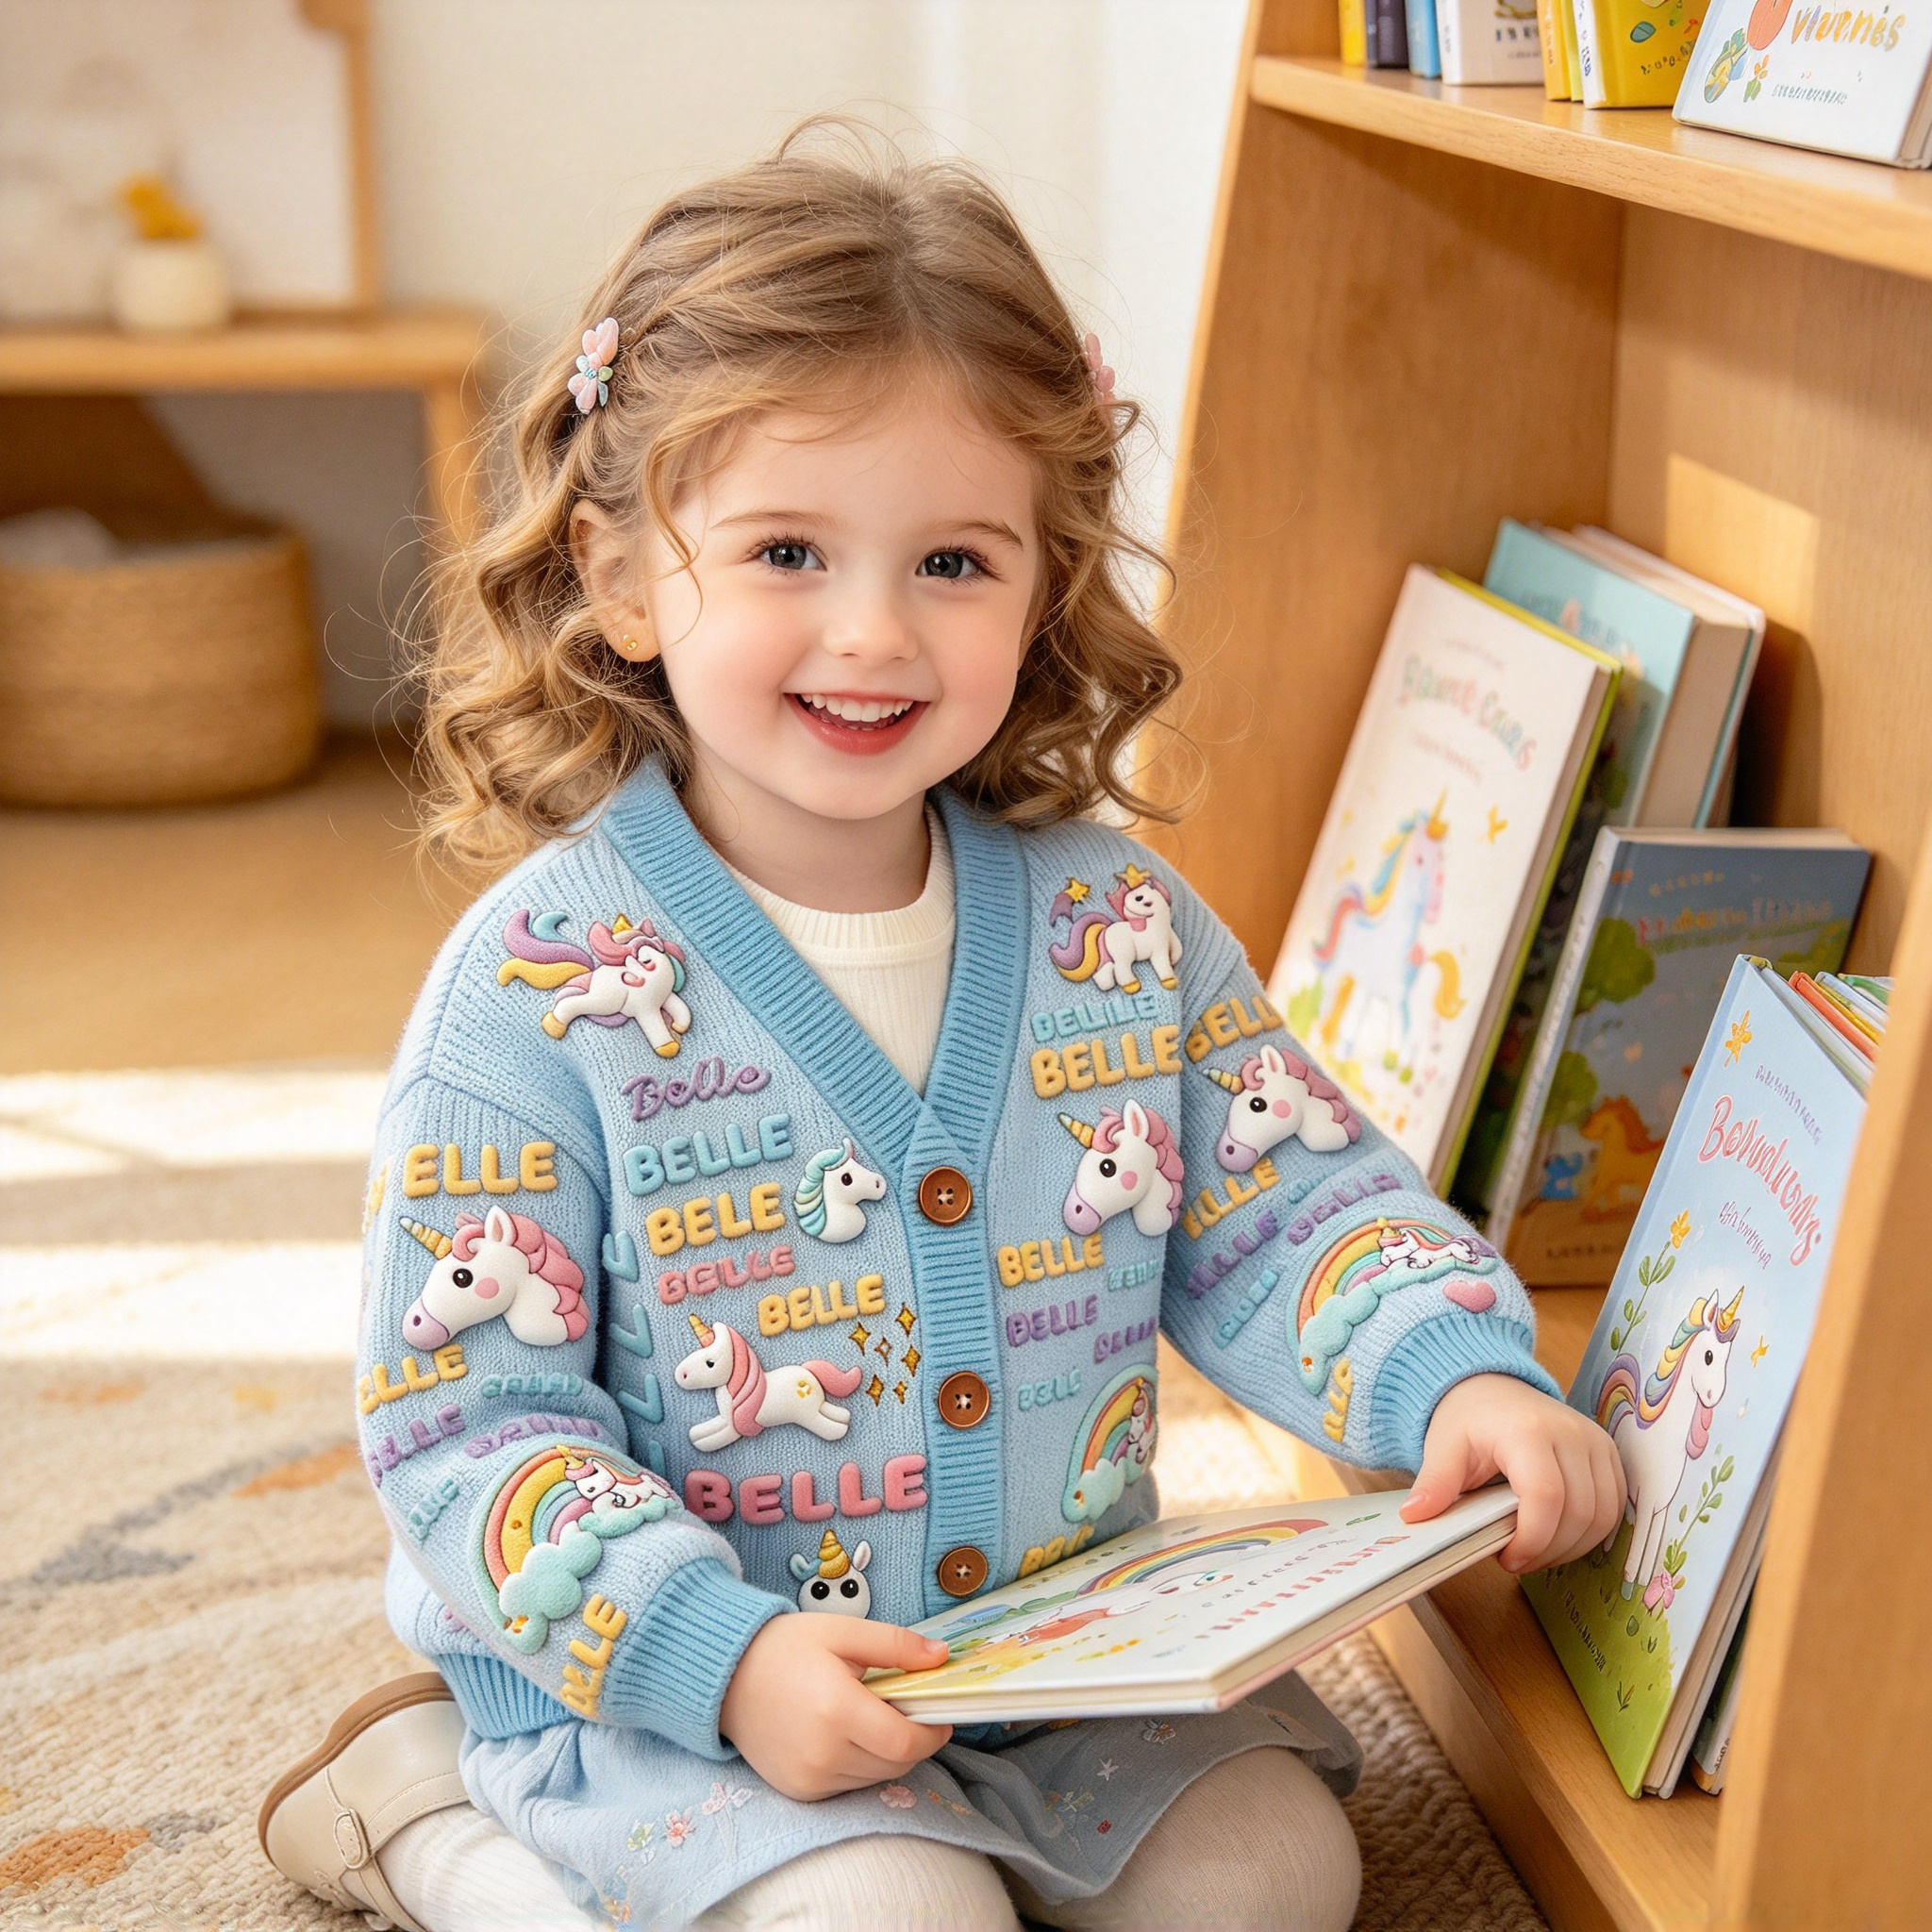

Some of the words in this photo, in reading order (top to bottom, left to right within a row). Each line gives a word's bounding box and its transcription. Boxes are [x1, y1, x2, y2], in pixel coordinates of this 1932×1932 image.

[621, 1056, 772, 1122] Belle
[1030, 1024, 1183, 1099] BELLE
[402, 1140, 558, 1199] ELLE
[623, 1113, 794, 1196] BELLE
[645, 1182, 787, 1256] BELE
[997, 1231, 1104, 1288] BELLE
[758, 1274, 887, 1338] BELLE
[1006, 1293, 1098, 1348] BELLE
[685, 1454, 928, 1524] BELLE
